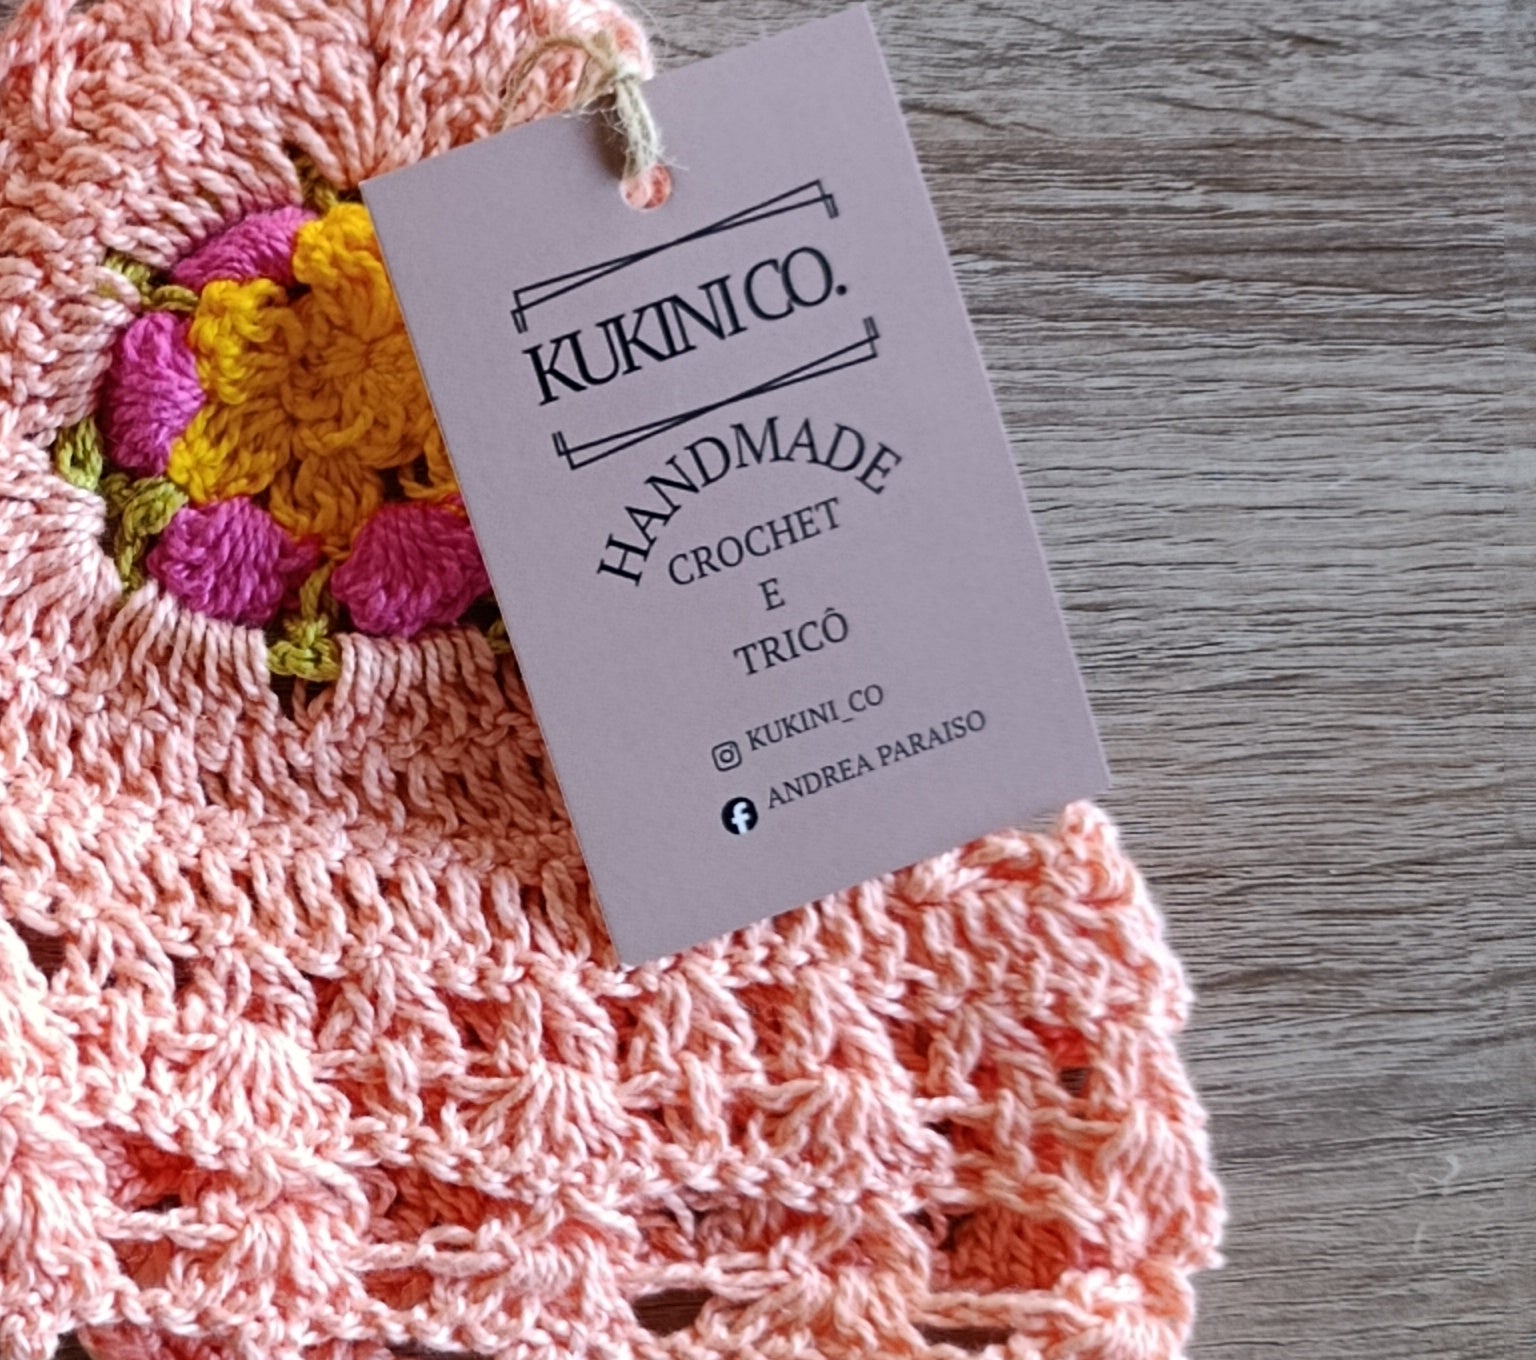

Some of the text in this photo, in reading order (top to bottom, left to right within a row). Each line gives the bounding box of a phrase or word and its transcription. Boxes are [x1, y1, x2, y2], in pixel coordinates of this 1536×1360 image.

[595, 415, 904, 588] HANDMADE
[667, 496, 840, 586] CROCHET
[757, 577, 787, 612] E
[732, 606, 850, 676] TRICÔ
[744, 683, 885, 752] KUKINI_CO
[767, 709, 987, 810] ANDREA PARAISO
